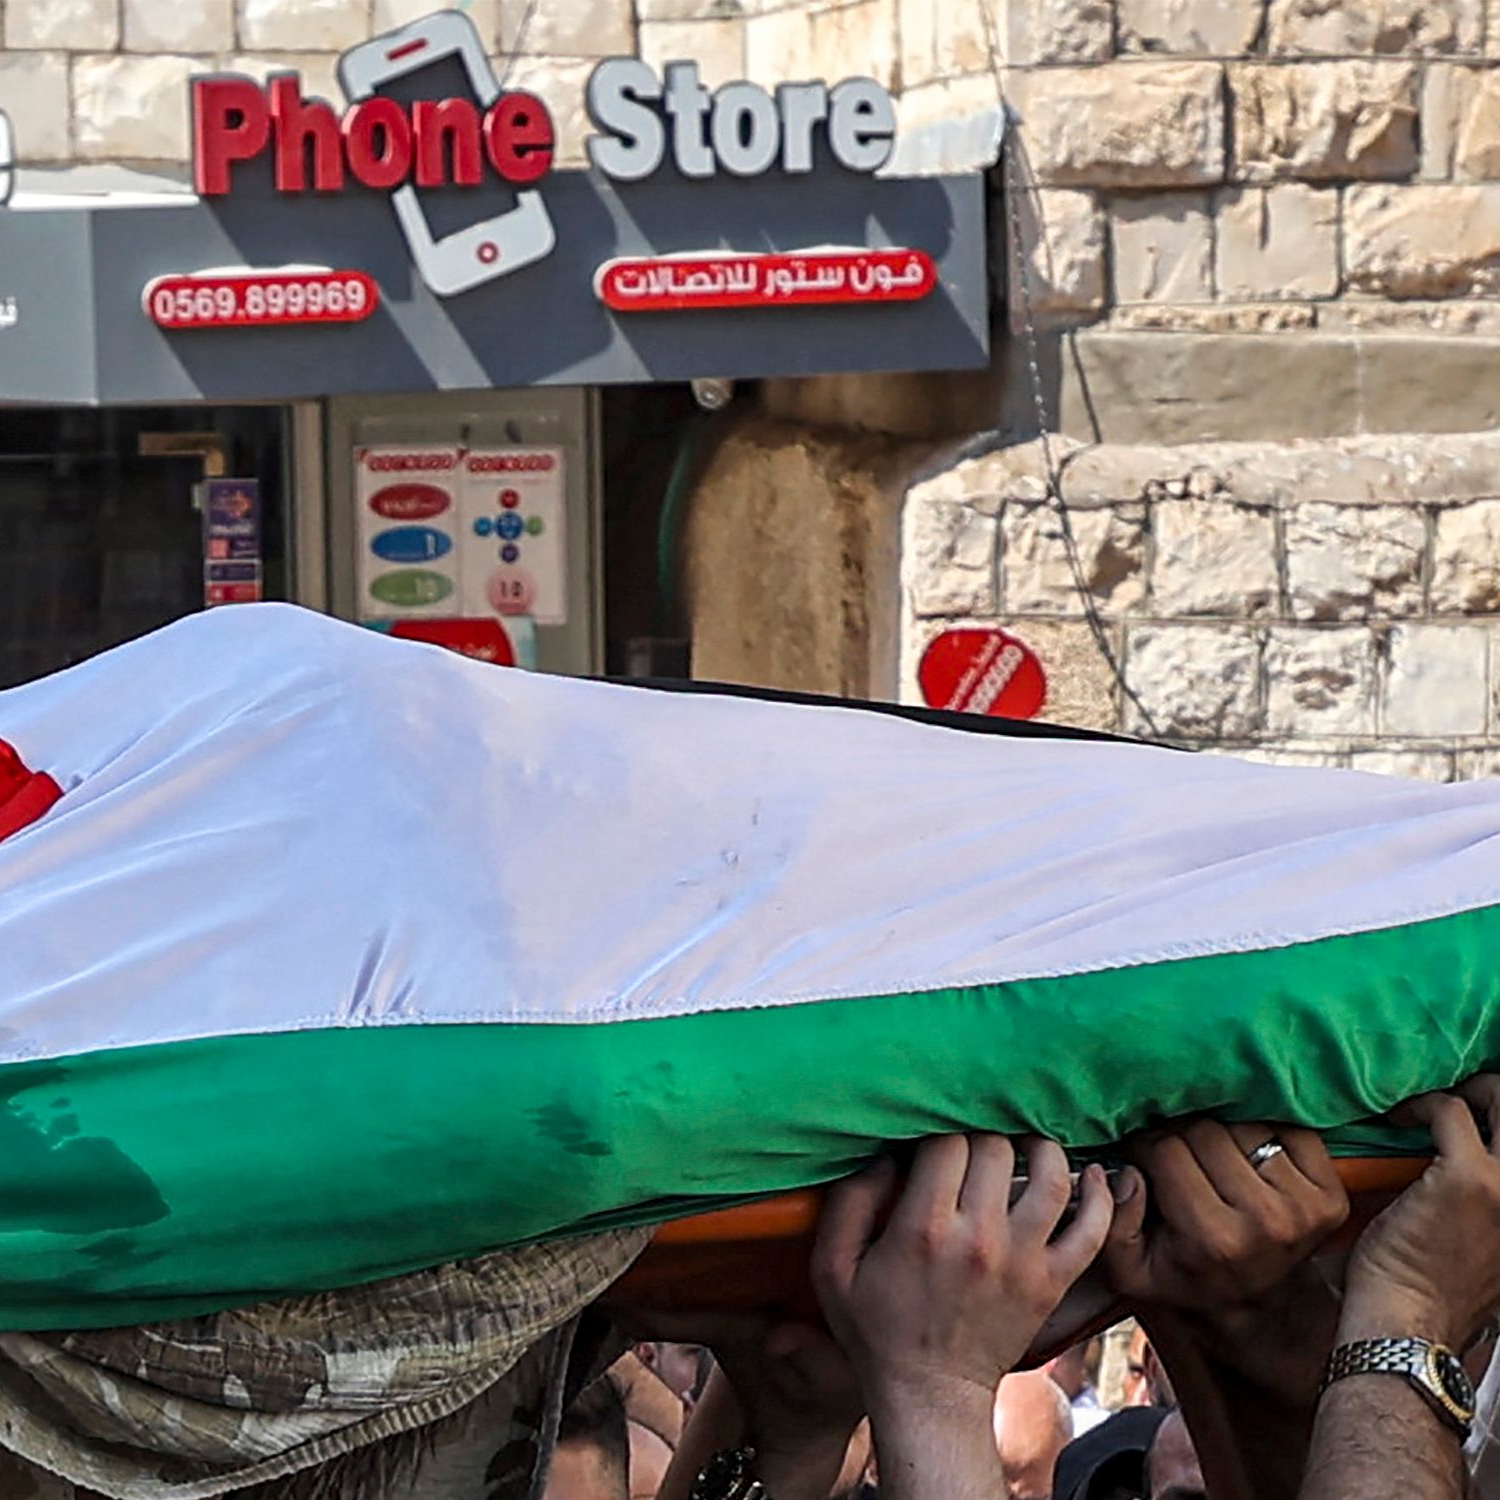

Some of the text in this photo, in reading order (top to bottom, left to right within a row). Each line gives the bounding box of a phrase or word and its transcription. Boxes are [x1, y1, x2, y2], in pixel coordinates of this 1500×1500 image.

[194, 58, 898, 194] Phone Store
[614, 254, 925, 297] فون ستور للاتصالات
[153, 280, 367, 322] 0569.899969
